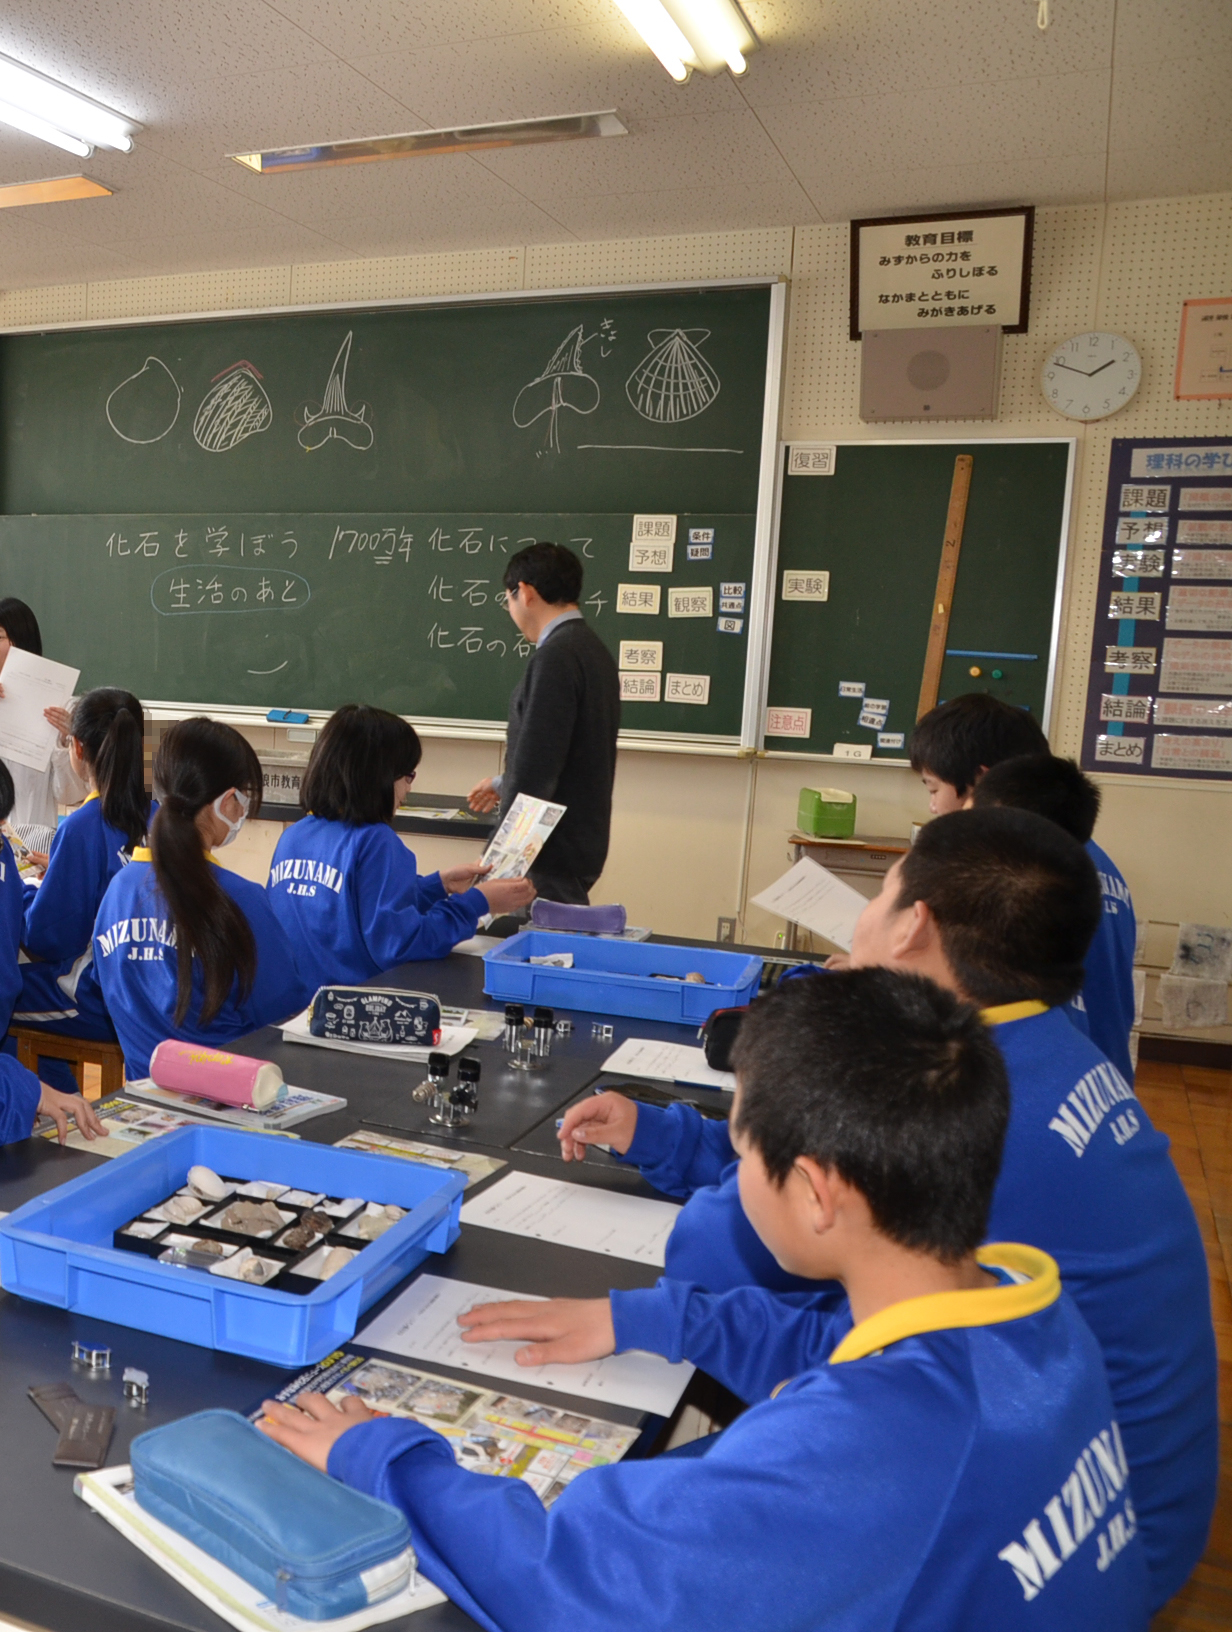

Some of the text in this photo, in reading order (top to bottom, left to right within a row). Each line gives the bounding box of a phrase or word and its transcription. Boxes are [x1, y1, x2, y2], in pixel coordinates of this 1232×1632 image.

[904, 230, 974, 247] 教育目標
[878, 251, 972, 266] みずからの力を
[931, 265, 998, 280] ふりしぼる
[878, 289, 970, 304] なかまとともに
[917, 304, 996, 318] みがきあげる
[1070, 342, 1079, 352] 11
[1089, 336, 1099, 347] 12
[1111, 339, 1115, 350] 1
[1055, 356, 1066, 366] 10
[1122, 352, 1130, 362] 2
[1047, 371, 1055, 381] 9
[1127, 369, 1134, 380] 3
[1051, 389, 1059, 399] 8
[1118, 387, 1126, 396] 4
[1064, 399, 1074, 410] 7
[1082, 403, 1090, 414] 6
[1102, 399, 1110, 409] 5
[794, 452, 828, 469] 復習
[1122, 488, 1167, 508] 課題
[637, 521, 670, 537] 課題
[691, 531, 711, 541] 条件
[1121, 521, 1164, 540] 予想
[106, 526, 298, 558] 化石を学ぼう
[635, 549, 667, 565] 予想
[690, 547, 710, 557] 疑問
[1118, 554, 1161, 573] 実験
[169, 574, 297, 607] 生活のあと
[723, 586, 742, 595] 比較
[788, 578, 823, 594] 実験
[621, 591, 654, 607] 結果
[674, 596, 707, 613] 観察
[1113, 596, 1156, 616] 結果
[724, 620, 735, 630] 図
[624, 649, 657, 665] 考察
[1109, 651, 1153, 670] 考察
[623, 679, 655, 695] 結論
[671, 681, 704, 697] まとめ
[1103, 699, 1147, 719] 結論
[770, 714, 805, 732] 注意点
[1099, 742, 1143, 758] まとめ
[271, 858, 343, 894] MIZUNAMI
